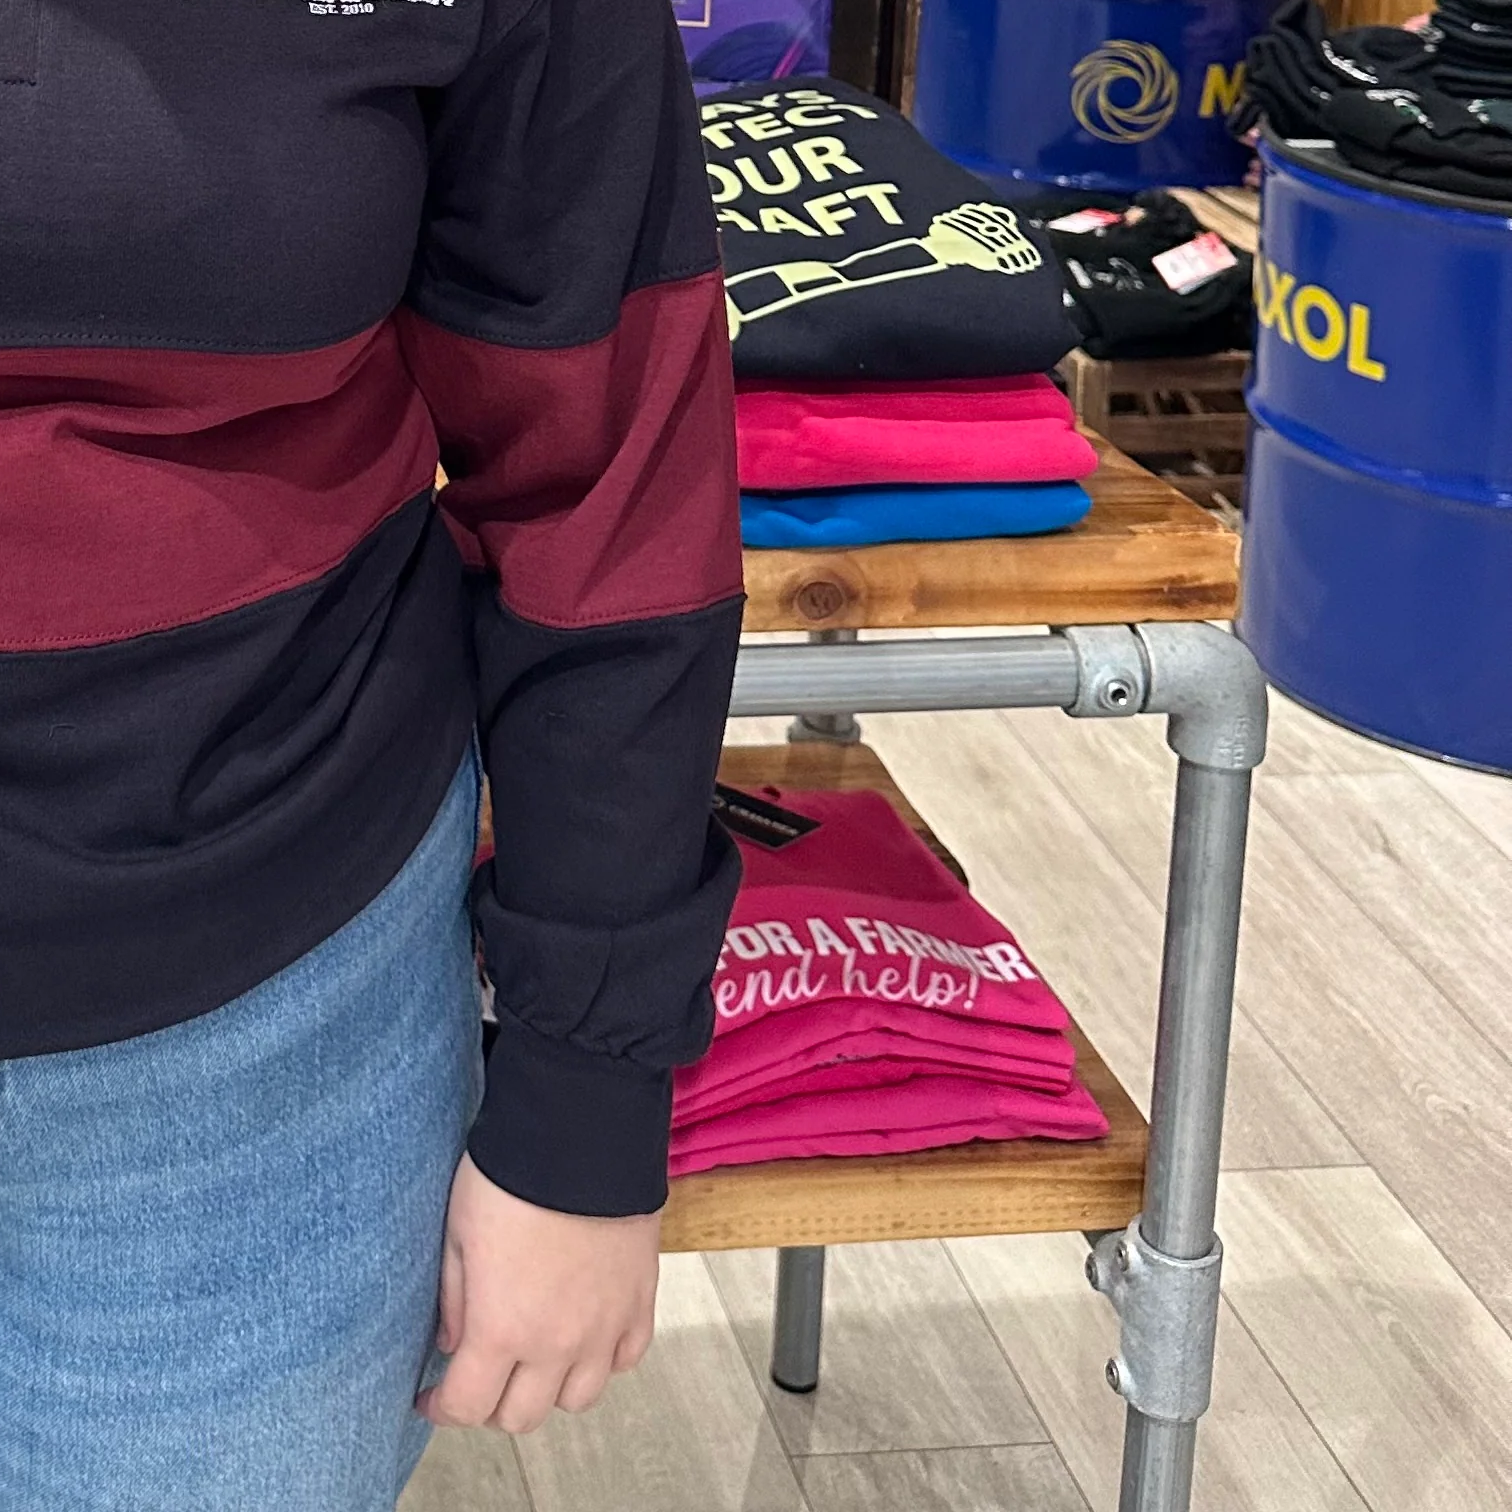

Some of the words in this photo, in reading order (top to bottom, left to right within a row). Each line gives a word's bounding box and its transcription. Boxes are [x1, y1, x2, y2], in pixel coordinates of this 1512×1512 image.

[308, 2, 338, 14] EST.
[341, 2, 374, 15] 2010
[806, 918, 845, 956] A
[844, 916, 1036, 983] FARMER
[841, 948, 980, 1009] help!
